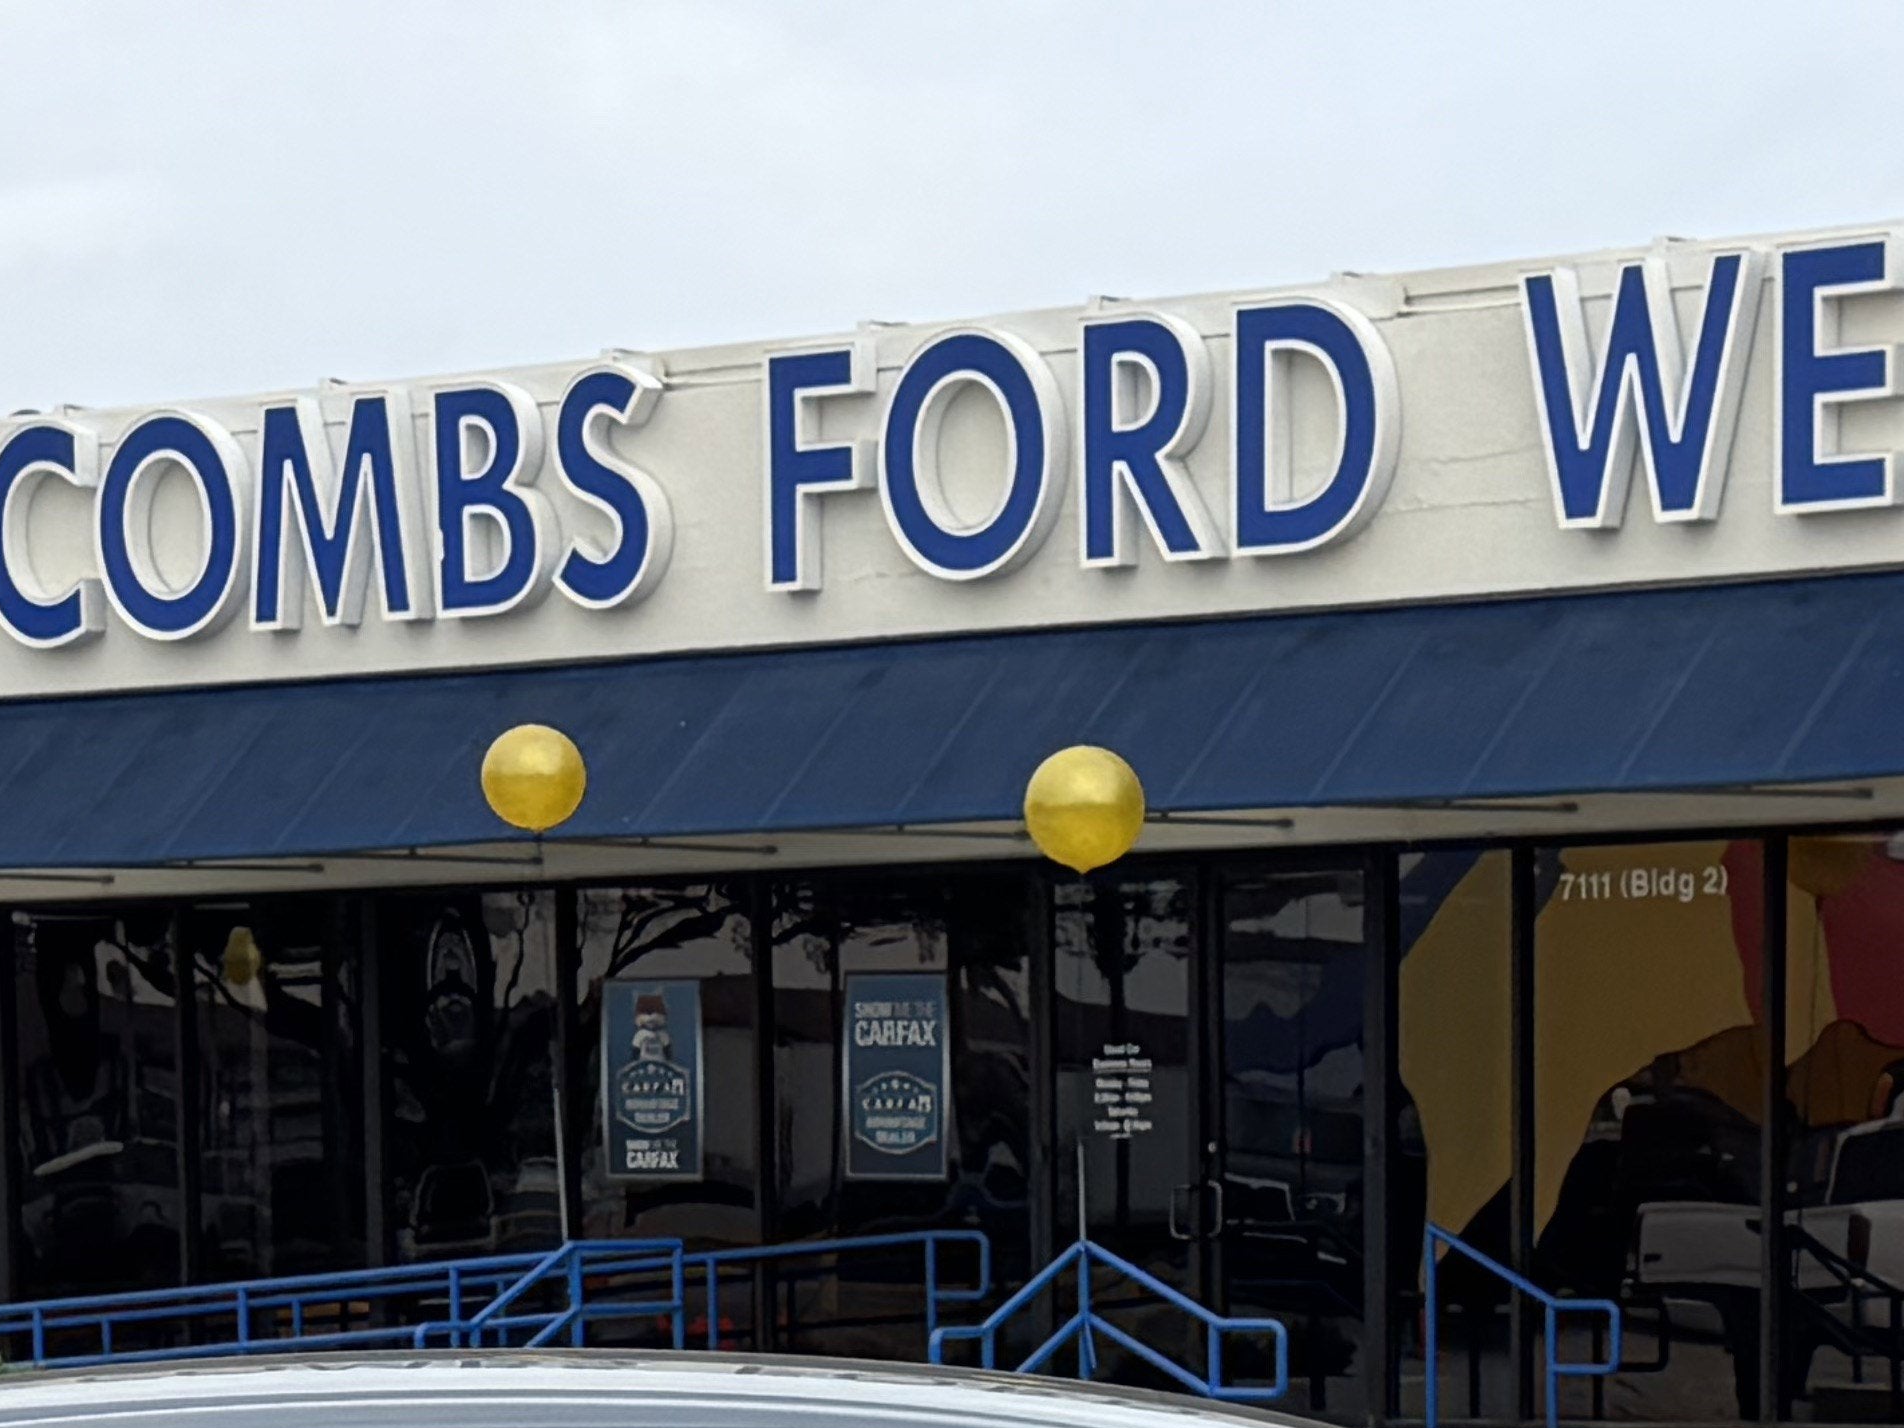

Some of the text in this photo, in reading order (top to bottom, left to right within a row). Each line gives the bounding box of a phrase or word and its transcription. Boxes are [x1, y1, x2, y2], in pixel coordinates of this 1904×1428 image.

[764, 299, 1393, 592] FORD
[1560, 864, 1729, 903] 7111 (Bldg 2)
[855, 1020, 936, 1047] CARFAX
